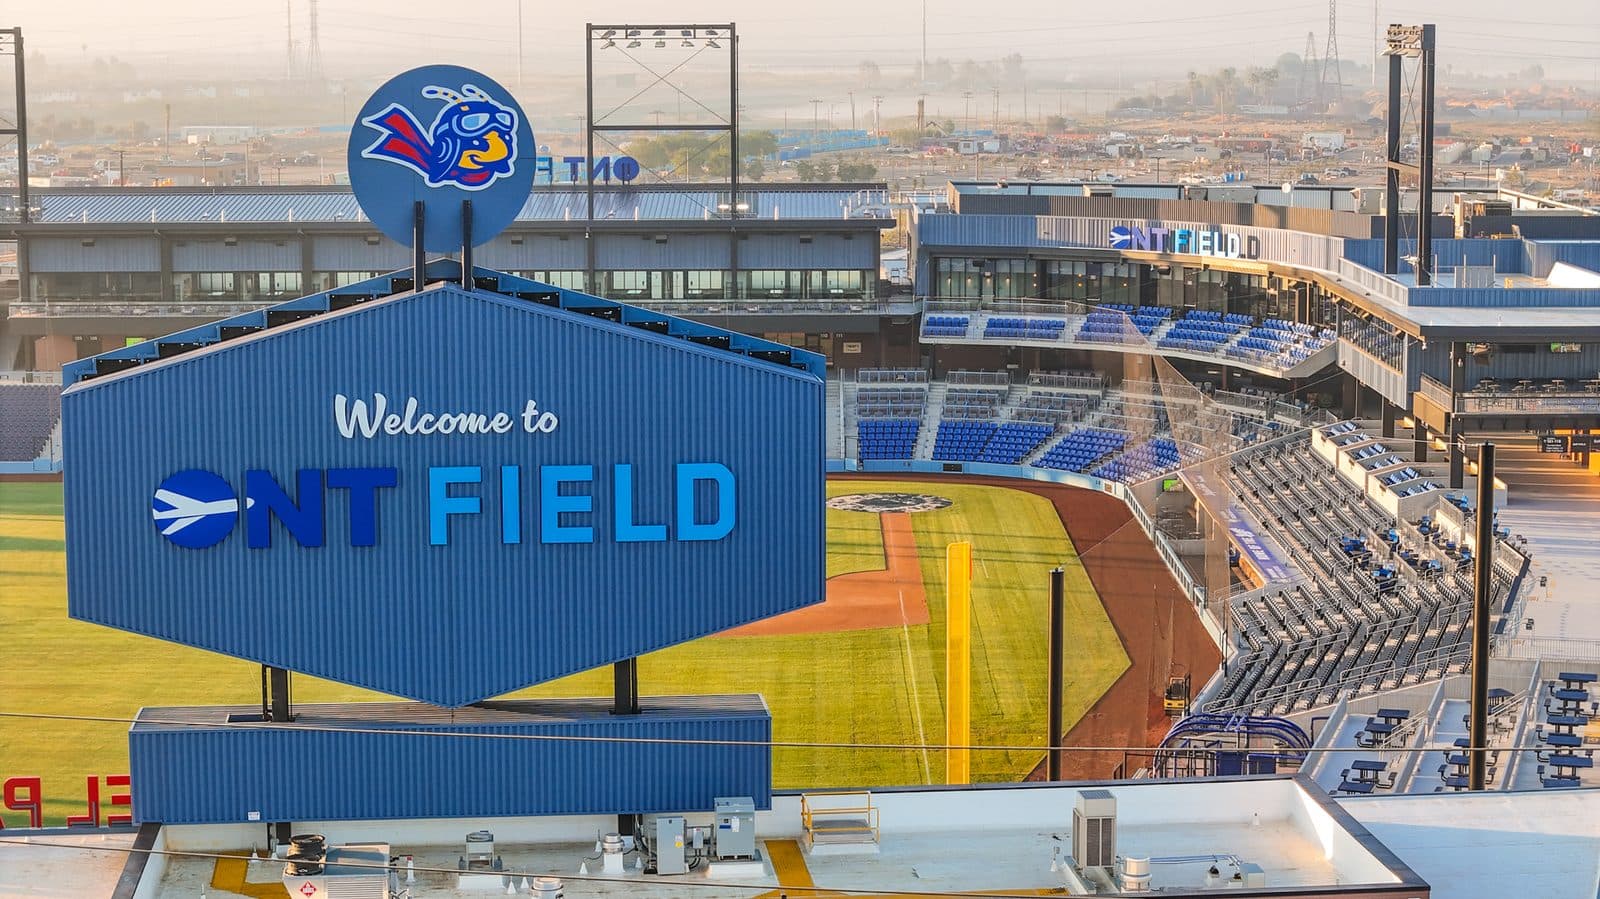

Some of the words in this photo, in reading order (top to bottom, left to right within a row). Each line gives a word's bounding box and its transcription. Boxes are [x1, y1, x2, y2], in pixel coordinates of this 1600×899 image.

[334, 393, 513, 439] Welcome
[522, 399, 559, 434] to
[152, 467, 398, 549] ONT
[429, 463, 736, 544] FIELD
